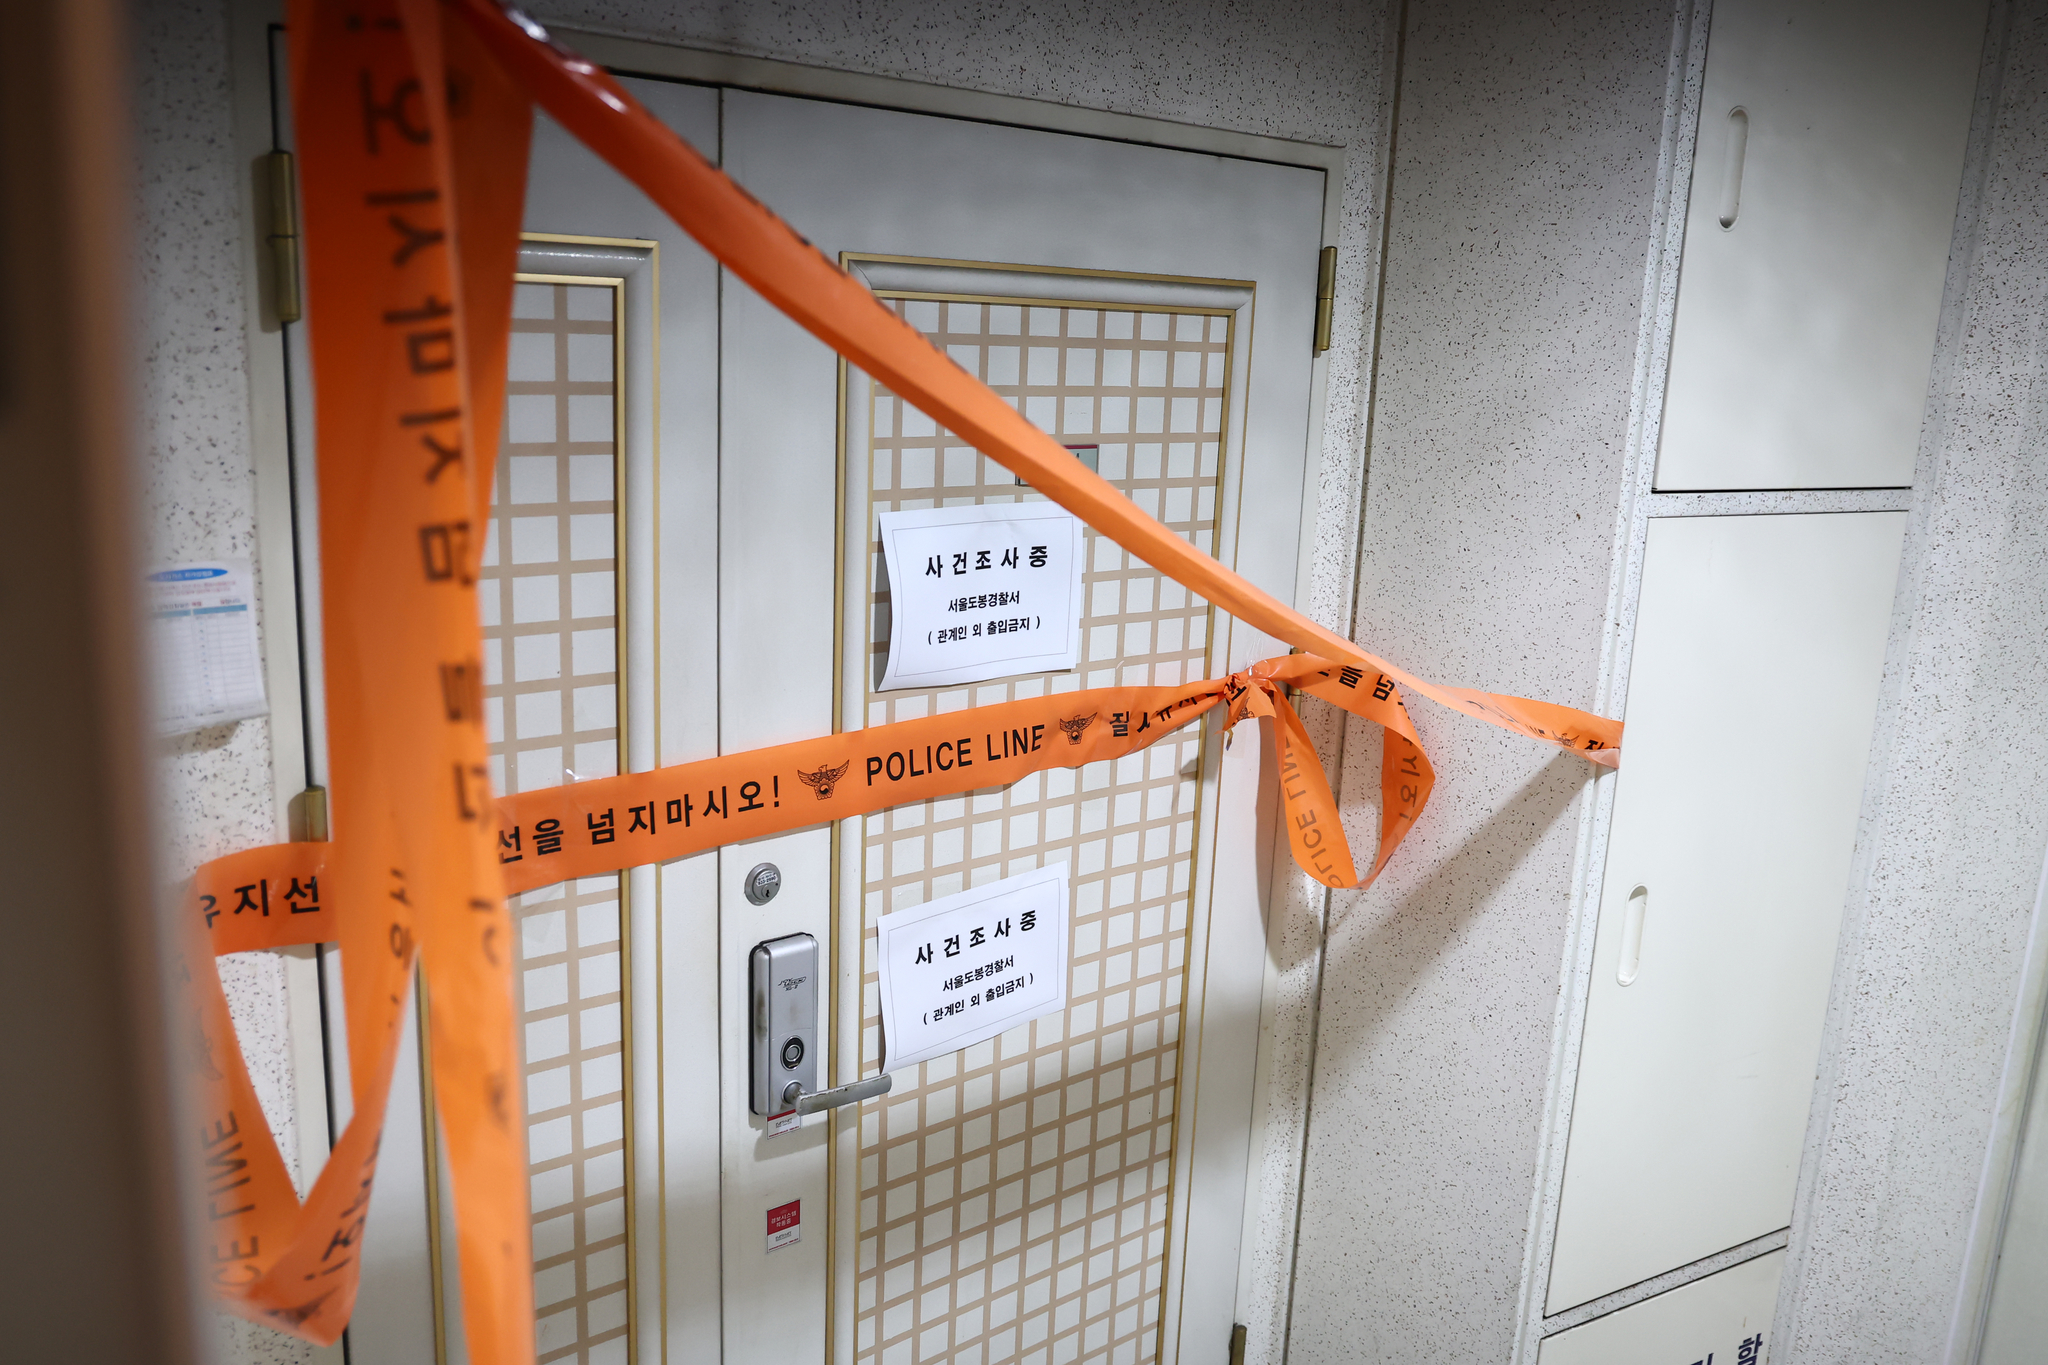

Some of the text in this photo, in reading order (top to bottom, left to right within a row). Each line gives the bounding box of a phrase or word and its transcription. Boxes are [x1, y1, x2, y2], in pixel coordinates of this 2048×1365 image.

[948, 590, 1021, 613] 서울도봉경찰서
[937, 625, 967, 644] 관계인
[972, 623, 982, 637] 외
[987, 617, 1030, 636] 출입금지
[866, 724, 1045, 786] POLICE LINE
[587, 775, 779, 845] 넘지마시오!
[943, 955, 1014, 992] 서울도봉경찰서
[933, 999, 965, 1022] 관계인
[970, 994, 980, 1007] 외
[985, 976, 1025, 1002] 출입금지
